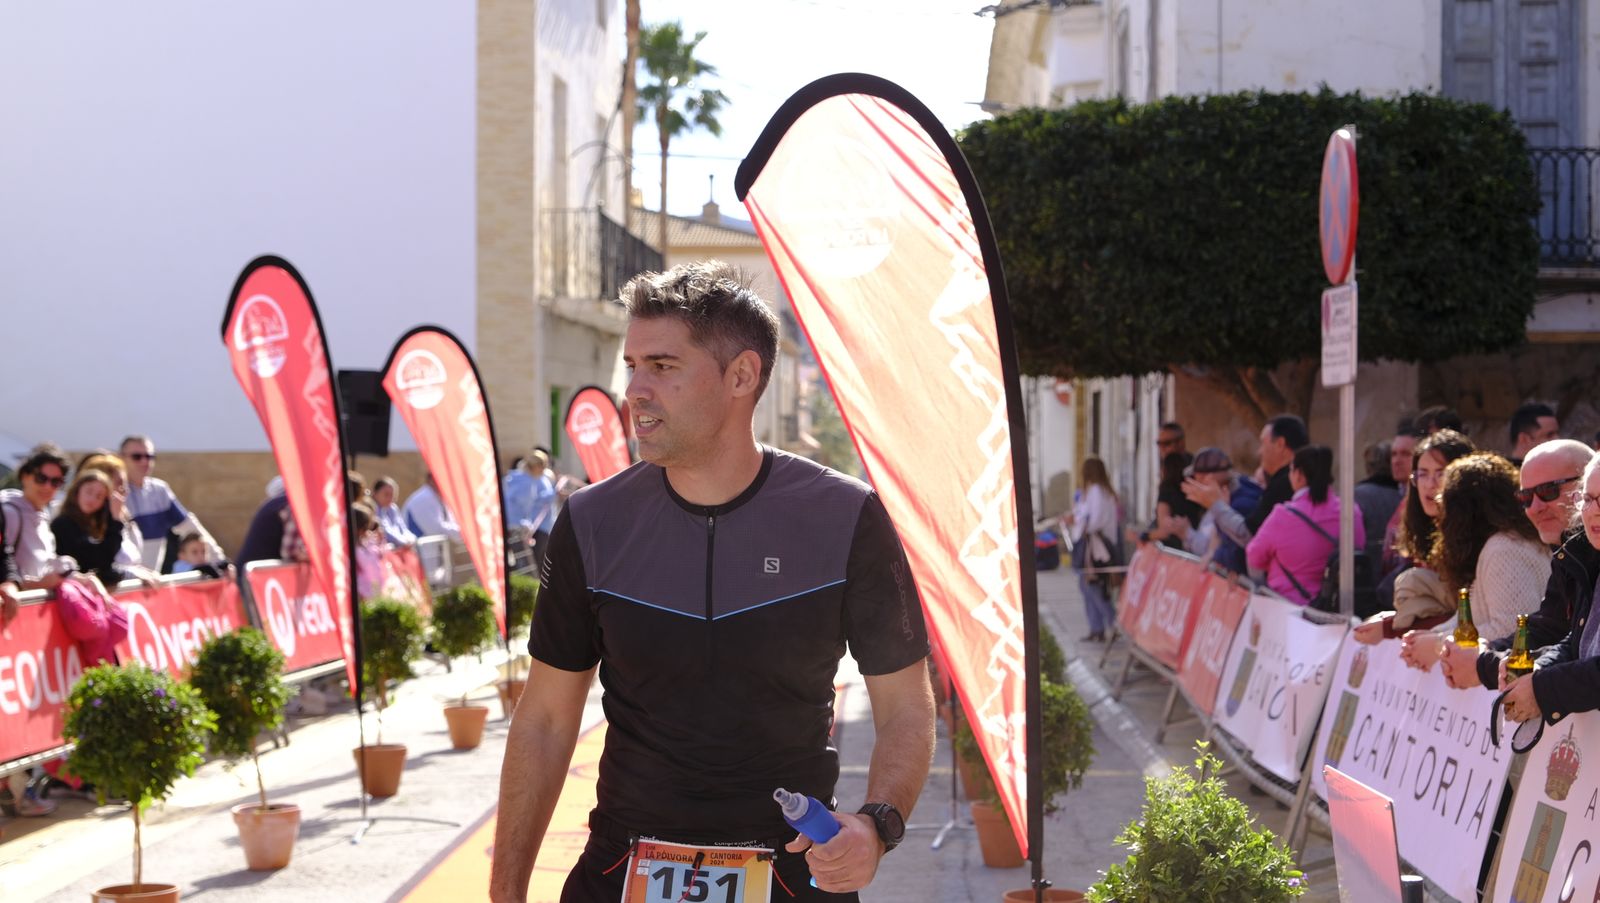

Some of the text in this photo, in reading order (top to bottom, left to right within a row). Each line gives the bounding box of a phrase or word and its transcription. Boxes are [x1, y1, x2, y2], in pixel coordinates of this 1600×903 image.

[1372, 680, 1477, 748] AYUNTAMIENTO
[1352, 714, 1493, 840] CANTORIA
[645, 850, 655, 859] LA
[710, 852, 743, 861] CANTORIA
[652, 866, 739, 903] 151
